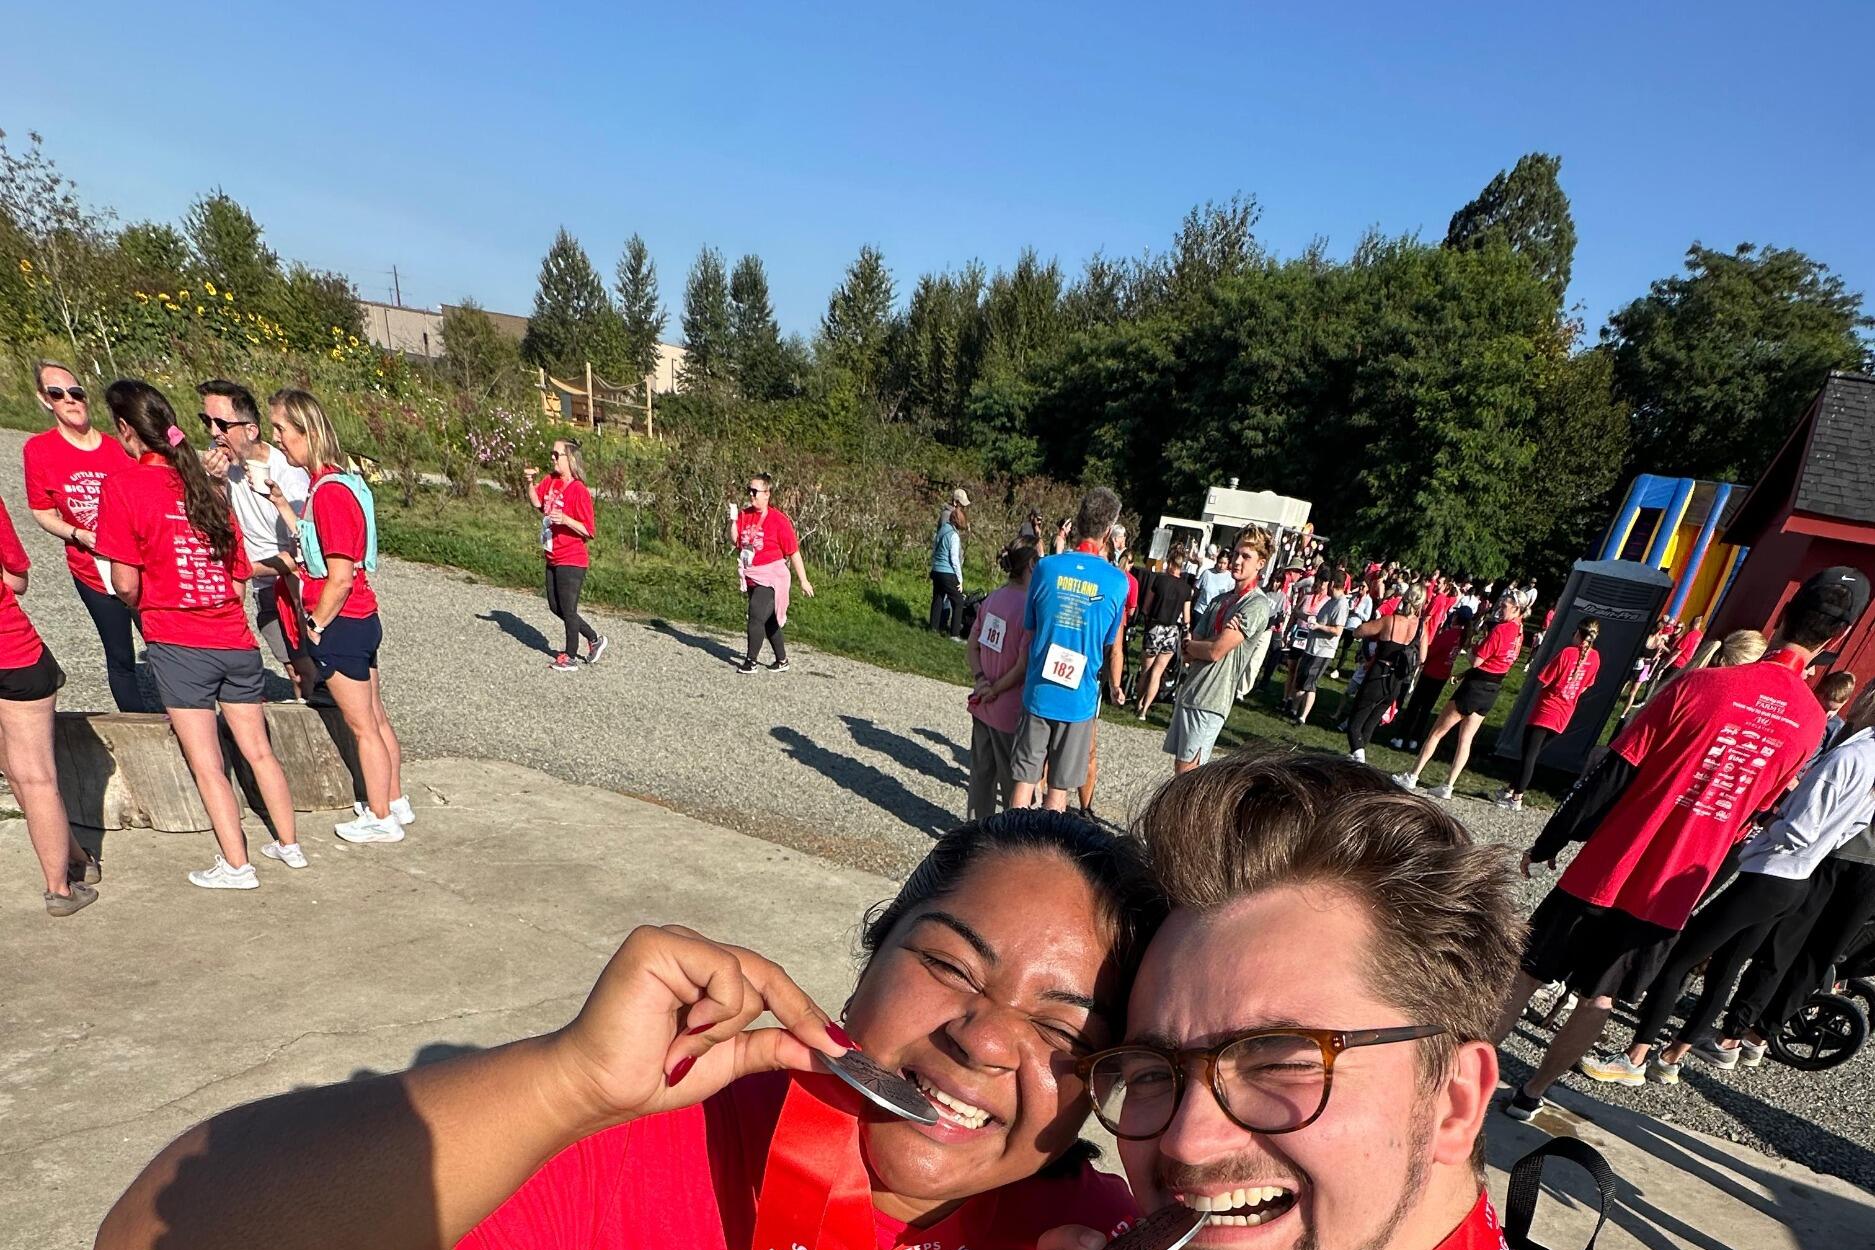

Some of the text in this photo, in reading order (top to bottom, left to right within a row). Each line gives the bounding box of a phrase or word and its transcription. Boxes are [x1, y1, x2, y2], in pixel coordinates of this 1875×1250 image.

[1056, 575, 1099, 597] PORTLAND
[987, 628, 1000, 644] 181
[1053, 661, 1075, 680] 182
